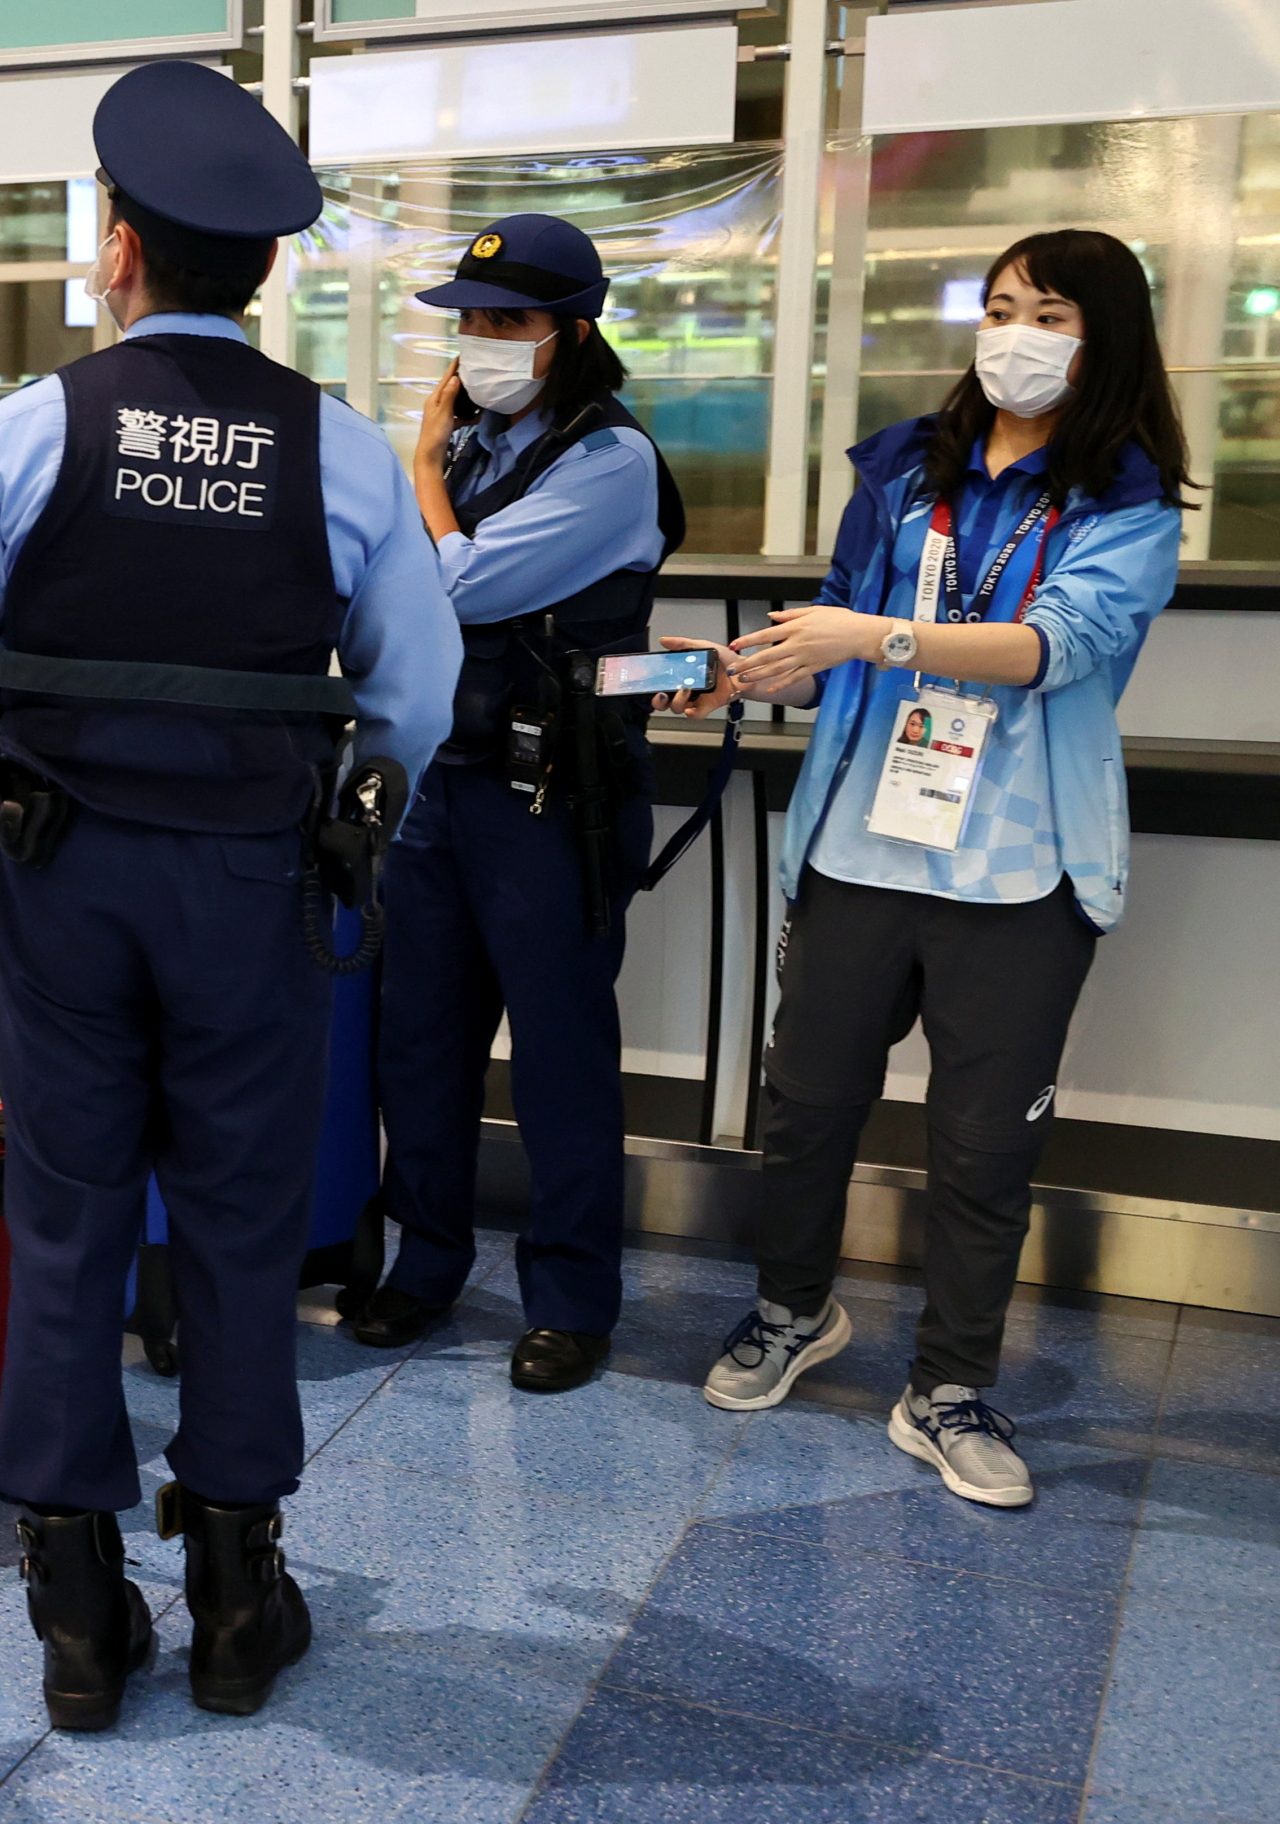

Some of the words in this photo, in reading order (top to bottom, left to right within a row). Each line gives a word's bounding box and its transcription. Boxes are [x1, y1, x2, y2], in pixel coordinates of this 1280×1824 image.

[116, 408, 275, 470] 警視庁
[115, 468, 266, 517] POLICE
[1015, 508, 1041, 535] TOKYO
[928, 538, 942, 564] 2020
[980, 563, 1003, 596] TOKYO
[997, 542, 1017, 565] 2020
[922, 564, 936, 601] TOKYO
[945, 559, 958, 592] TOKYO
